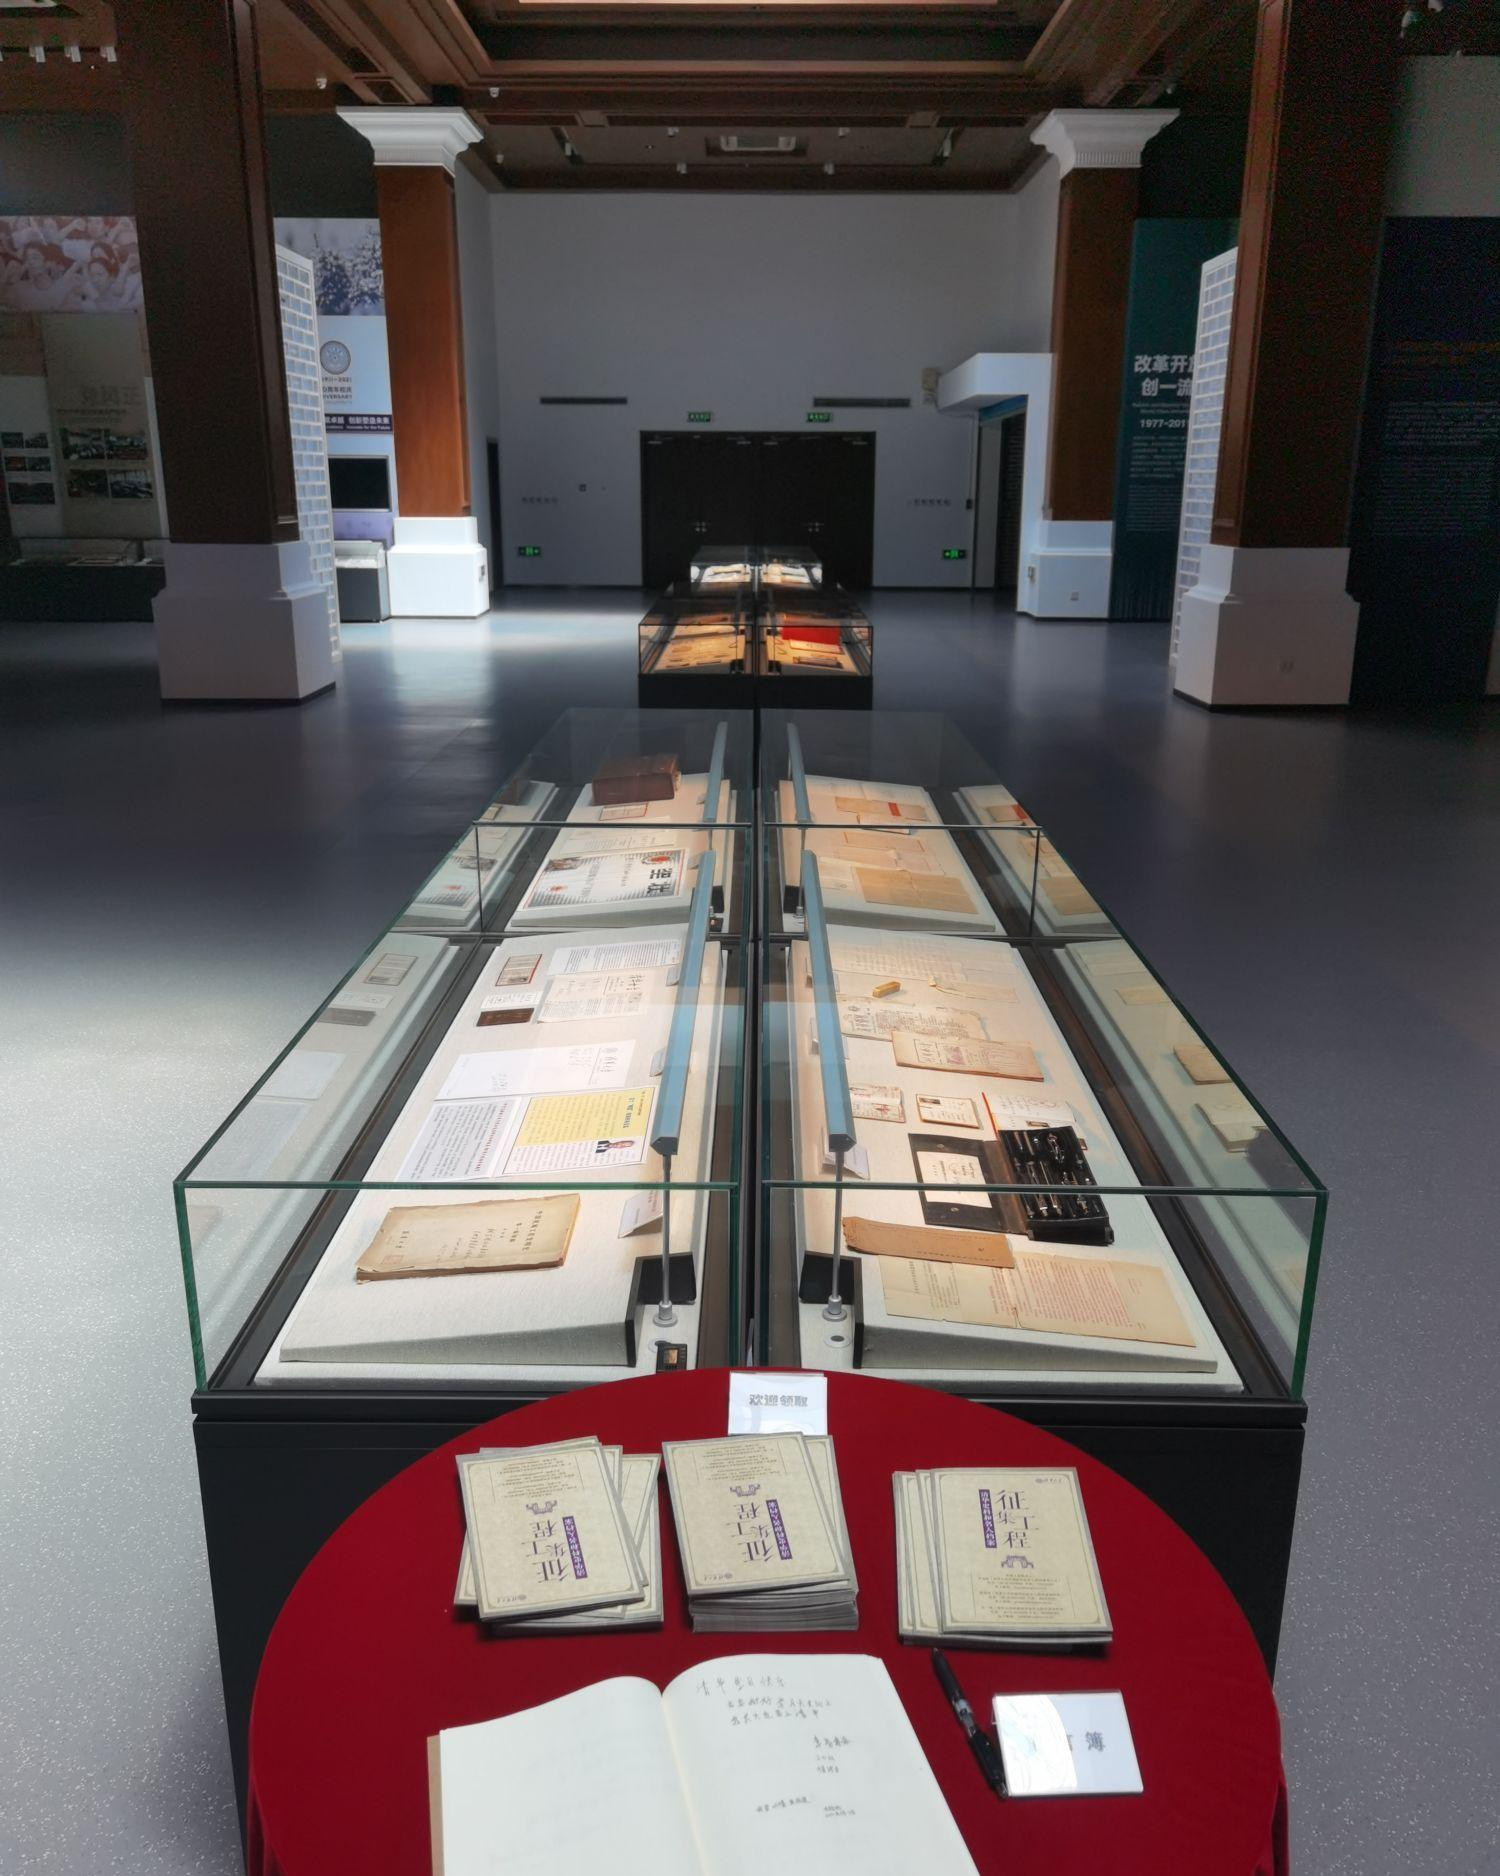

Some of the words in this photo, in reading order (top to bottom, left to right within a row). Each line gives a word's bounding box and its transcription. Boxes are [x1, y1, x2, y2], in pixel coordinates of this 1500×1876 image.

[1140, 419, 1189, 429] 1977-201
[749, 1393, 808, 1407] 欢迎领取
